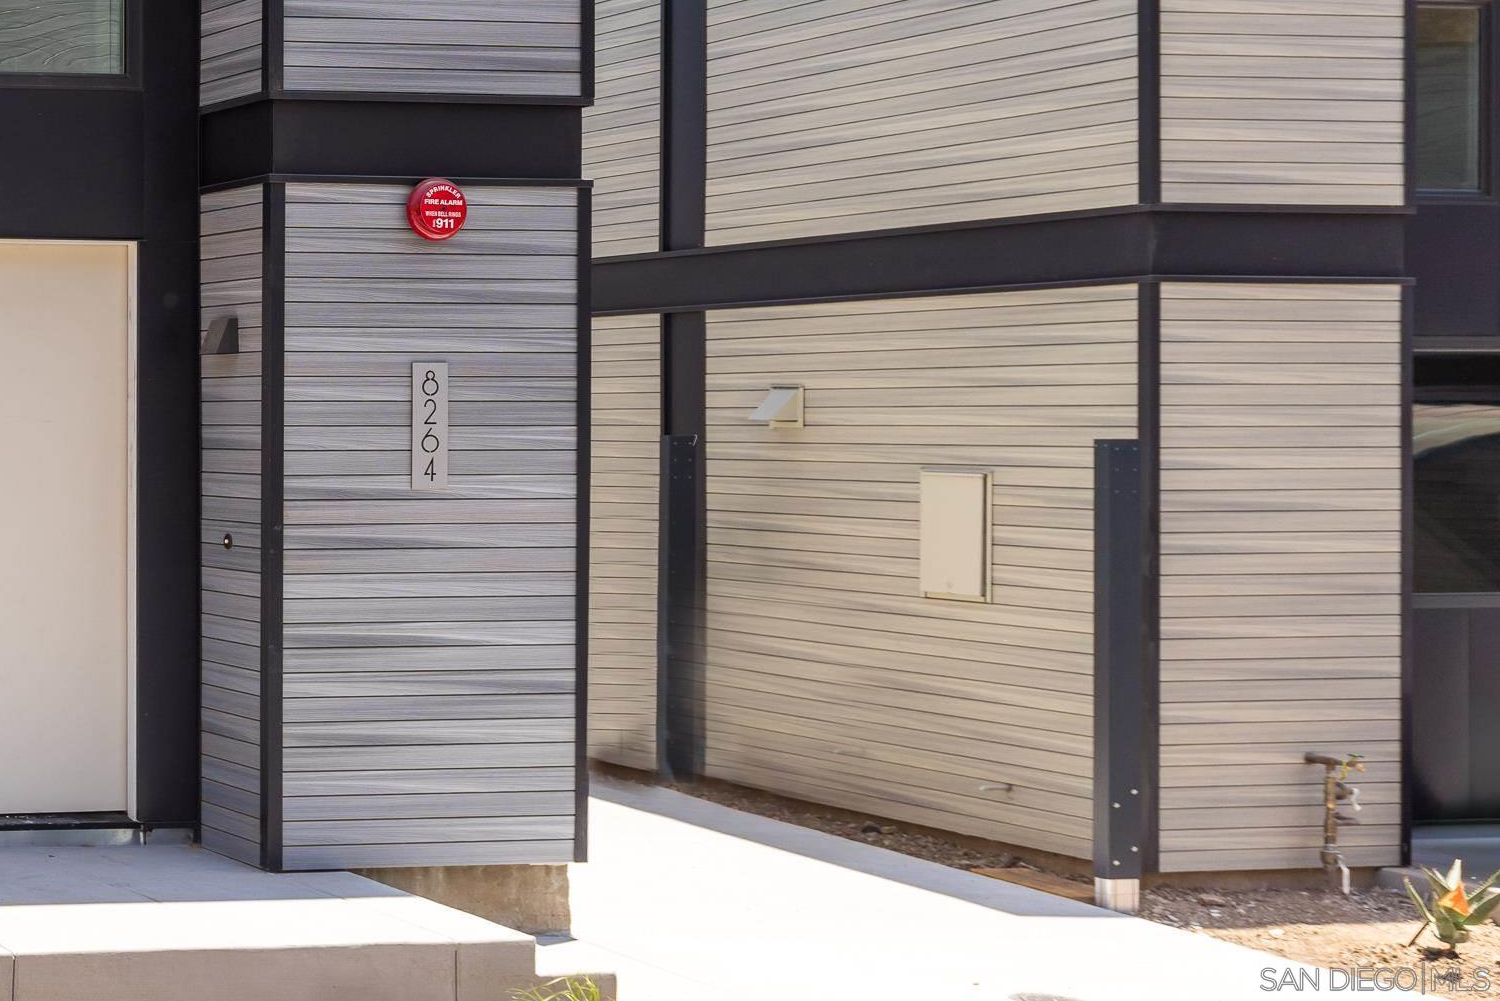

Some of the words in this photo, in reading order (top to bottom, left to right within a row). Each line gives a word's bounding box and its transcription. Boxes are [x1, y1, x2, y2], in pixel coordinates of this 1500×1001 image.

[426, 185, 461, 199] SPRINKLER
[436, 218, 454, 229] 911
[421, 370, 439, 482] 8264
